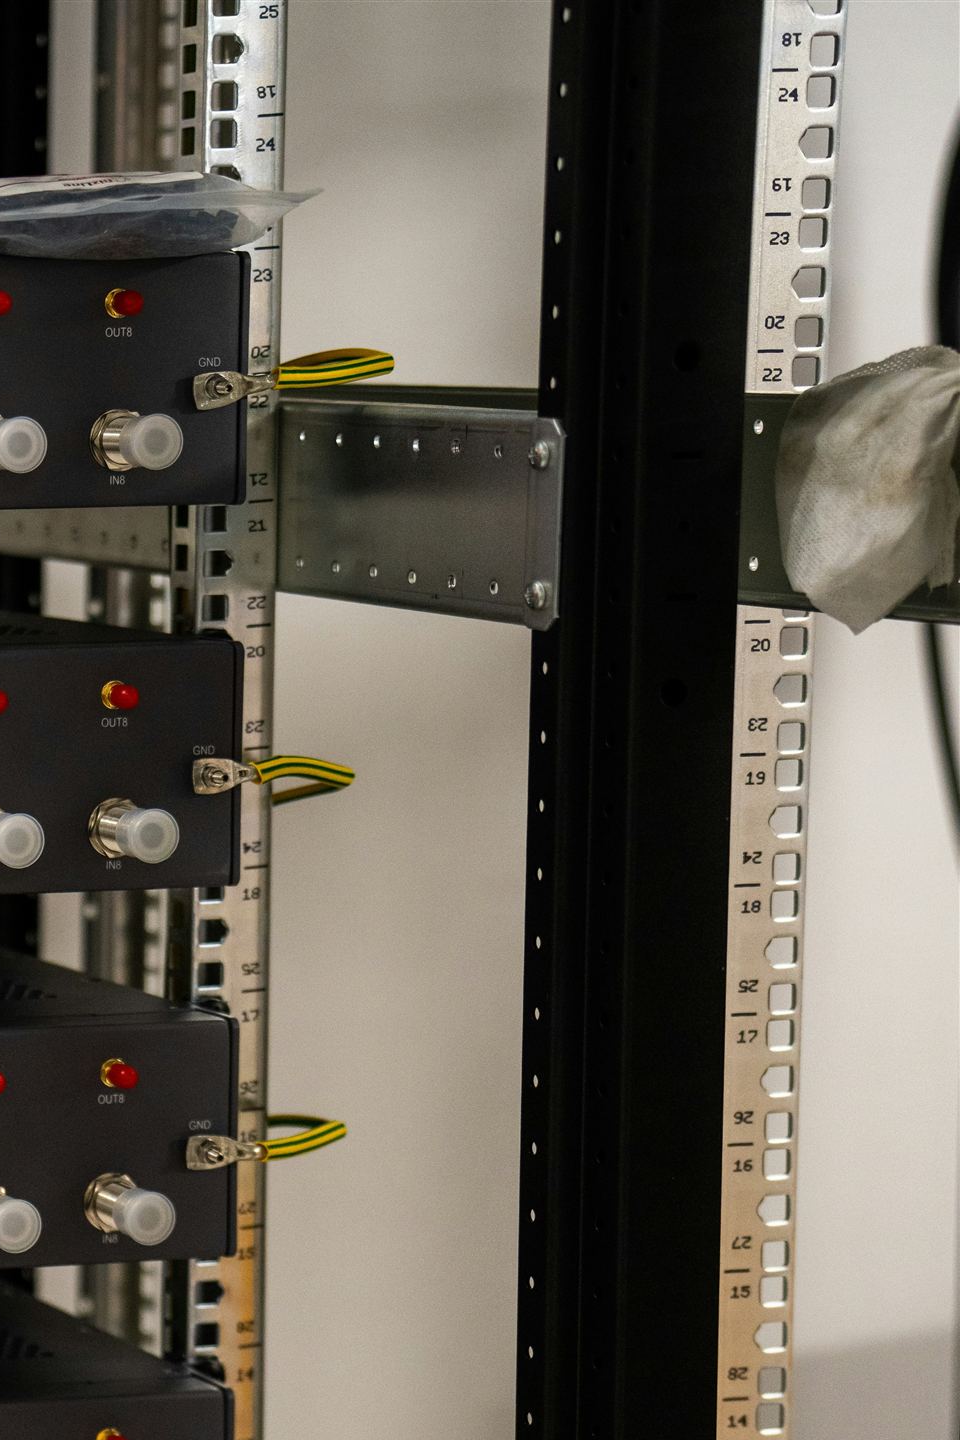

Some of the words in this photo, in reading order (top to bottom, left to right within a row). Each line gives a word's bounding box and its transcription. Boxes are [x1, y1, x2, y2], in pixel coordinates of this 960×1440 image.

[259, 6, 279, 19] 25
[778, 88, 798, 102] 24
[256, 138, 275, 151] 24
[770, 231, 790, 245] 23
[253, 270, 272, 282] 23
[105, 327, 132, 337] OUT8
[198, 357, 221, 367] GND
[762, 368, 782, 382] 22
[250, 396, 268, 408] 22
[110, 475, 125, 485] IN8
[249, 521, 267, 532] 21
[751, 638, 770, 652] 20
[247, 647, 265, 658] 20
[101, 717, 128, 728] OUT8
[193, 746, 214, 754] GND
[745, 771, 765, 785] 19
[106, 859, 122, 870] IN8
[243, 889, 260, 900] 18
[741, 900, 761, 914] 18
[241, 1010, 259, 1022] 17
[737, 1030, 758, 1044] 17
[98, 1093, 125, 1104] OUT8
[189, 1119, 211, 1130] GND
[733, 1159, 753, 1172] 16
[102, 1233, 118, 1244] IN8
[731, 1285, 751, 1299] 15
[728, 1415, 747, 1428] 14
